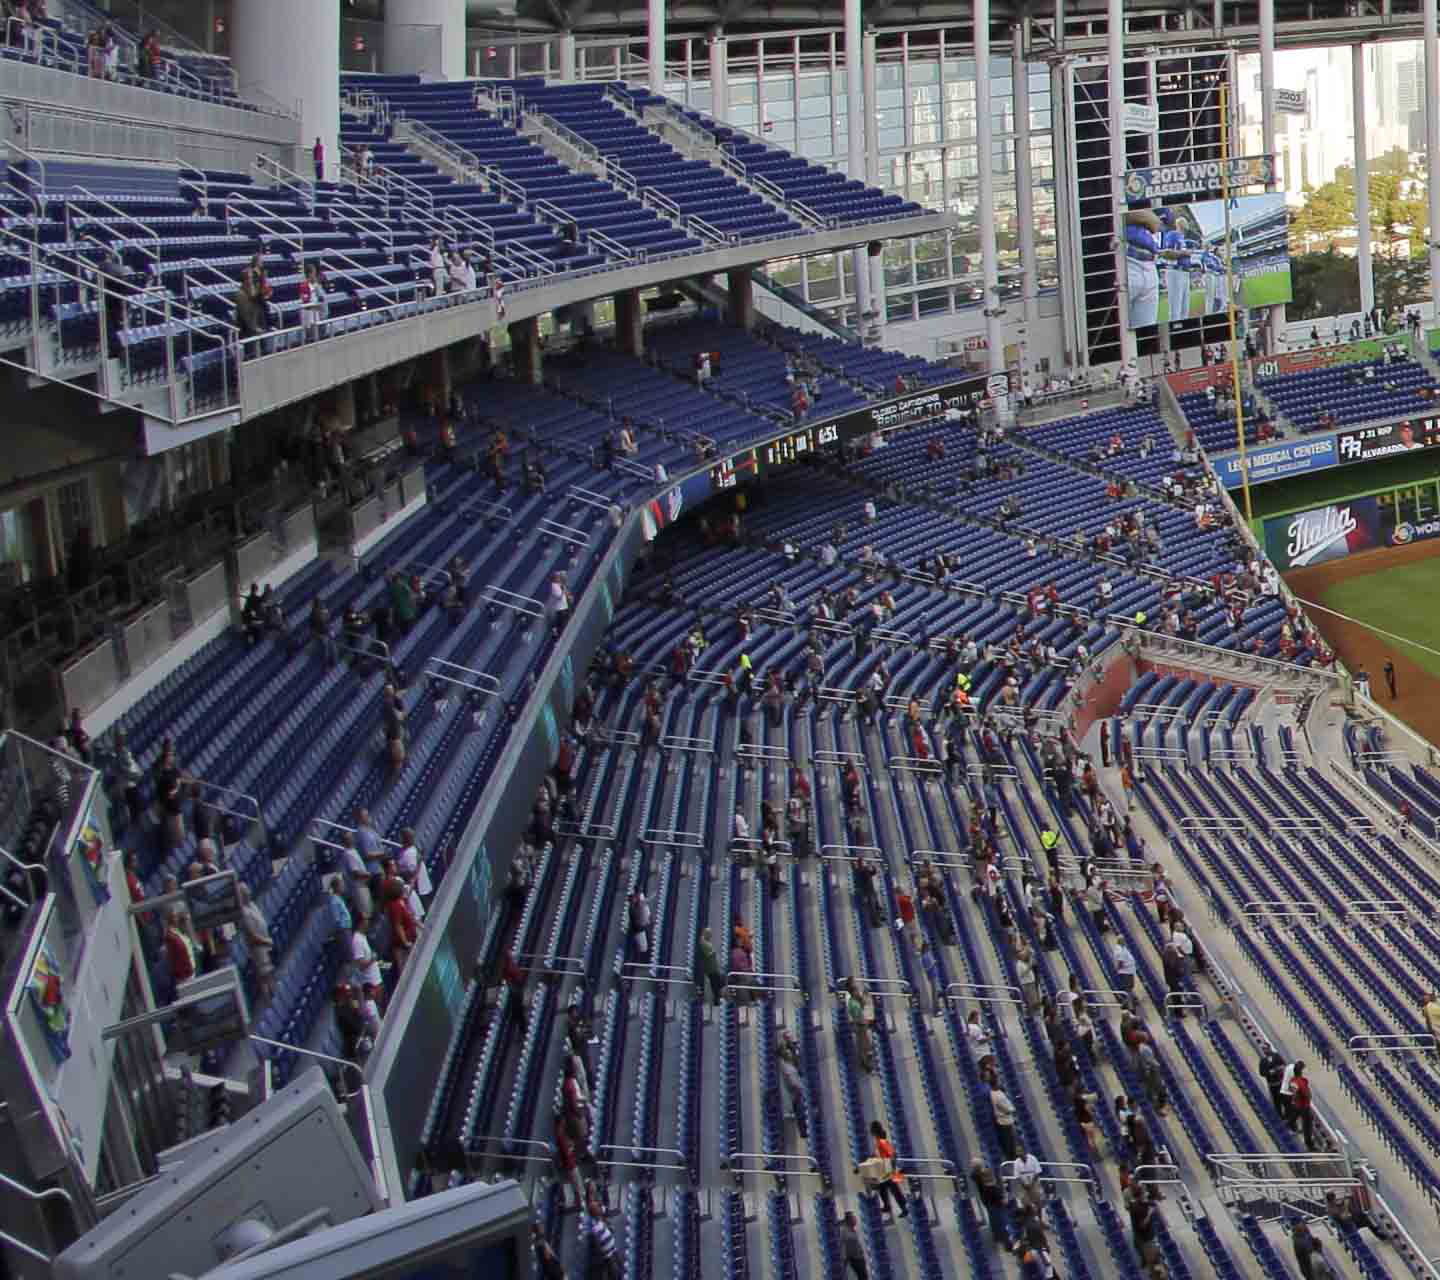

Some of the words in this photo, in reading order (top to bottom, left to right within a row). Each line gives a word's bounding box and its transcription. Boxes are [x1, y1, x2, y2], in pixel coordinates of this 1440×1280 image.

[1152, 167, 1188, 185] 2013
[1256, 360, 1279, 377] 401
[1253, 450, 1292, 467] MEDICAL
[1294, 440, 1333, 458] CENTERS
[1287, 505, 1357, 568] Italia
